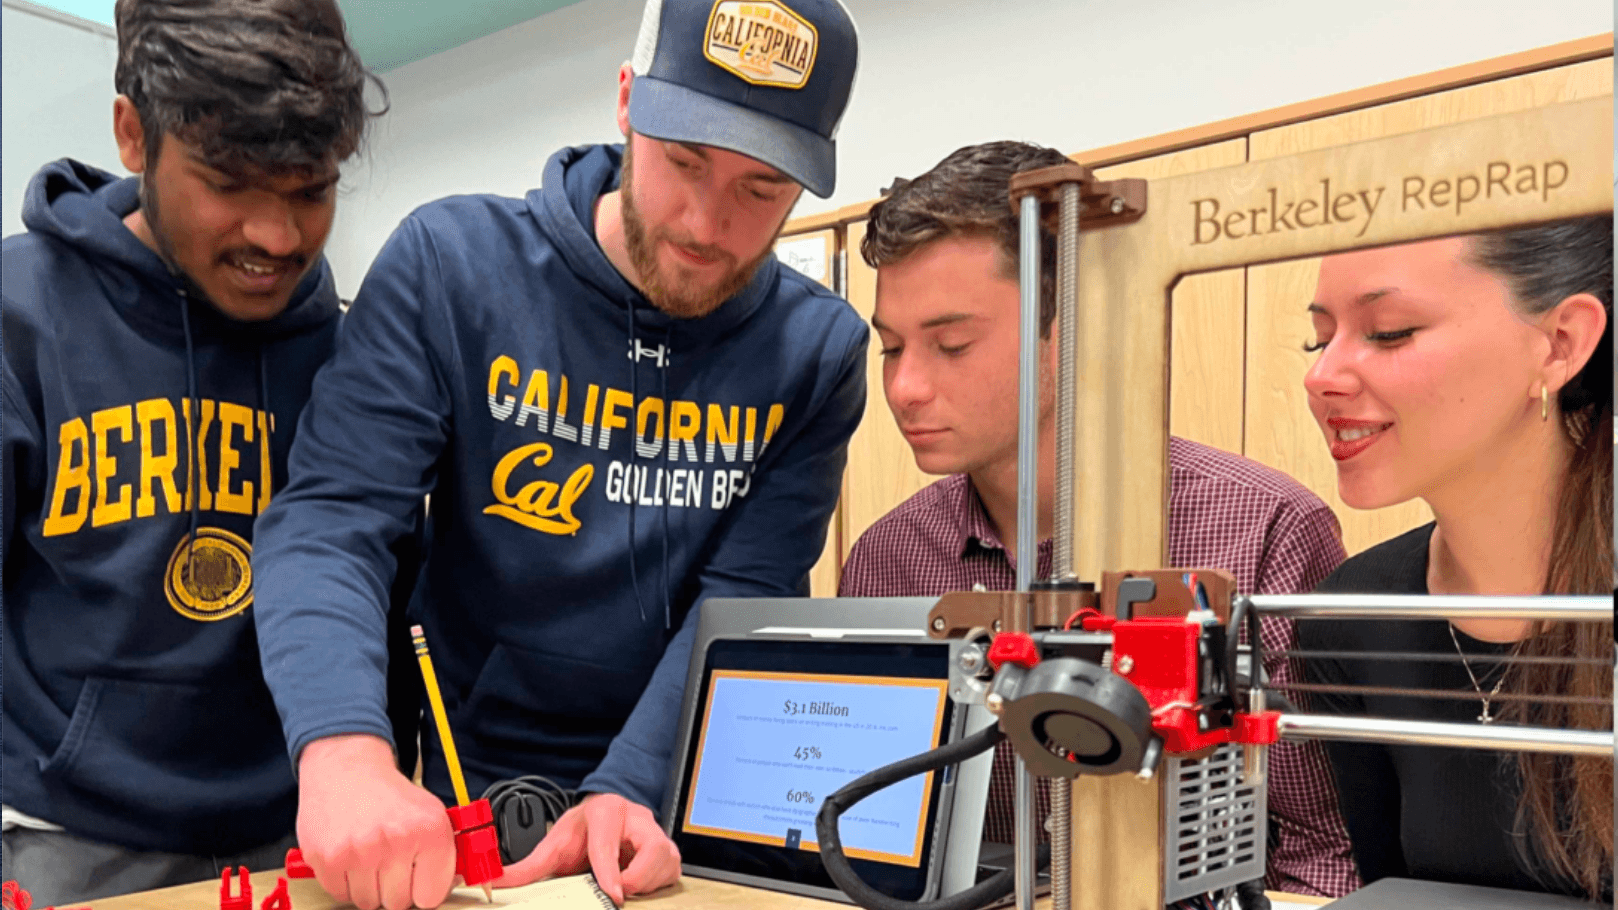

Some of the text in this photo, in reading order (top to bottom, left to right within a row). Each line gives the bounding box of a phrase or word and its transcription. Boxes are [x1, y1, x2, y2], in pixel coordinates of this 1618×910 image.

[713, 13, 808, 69] CALIFORNIA
[1189, 159, 1569, 247] Berkeley RepRap
[488, 355, 784, 462] CALIFORNIA
[482, 442, 594, 536] Cal
[605, 461, 703, 508] GOLDEN
[783, 700, 849, 717] $3.1 Billion
[793, 746, 822, 760] 45%
[786, 789, 815, 804] 60%
